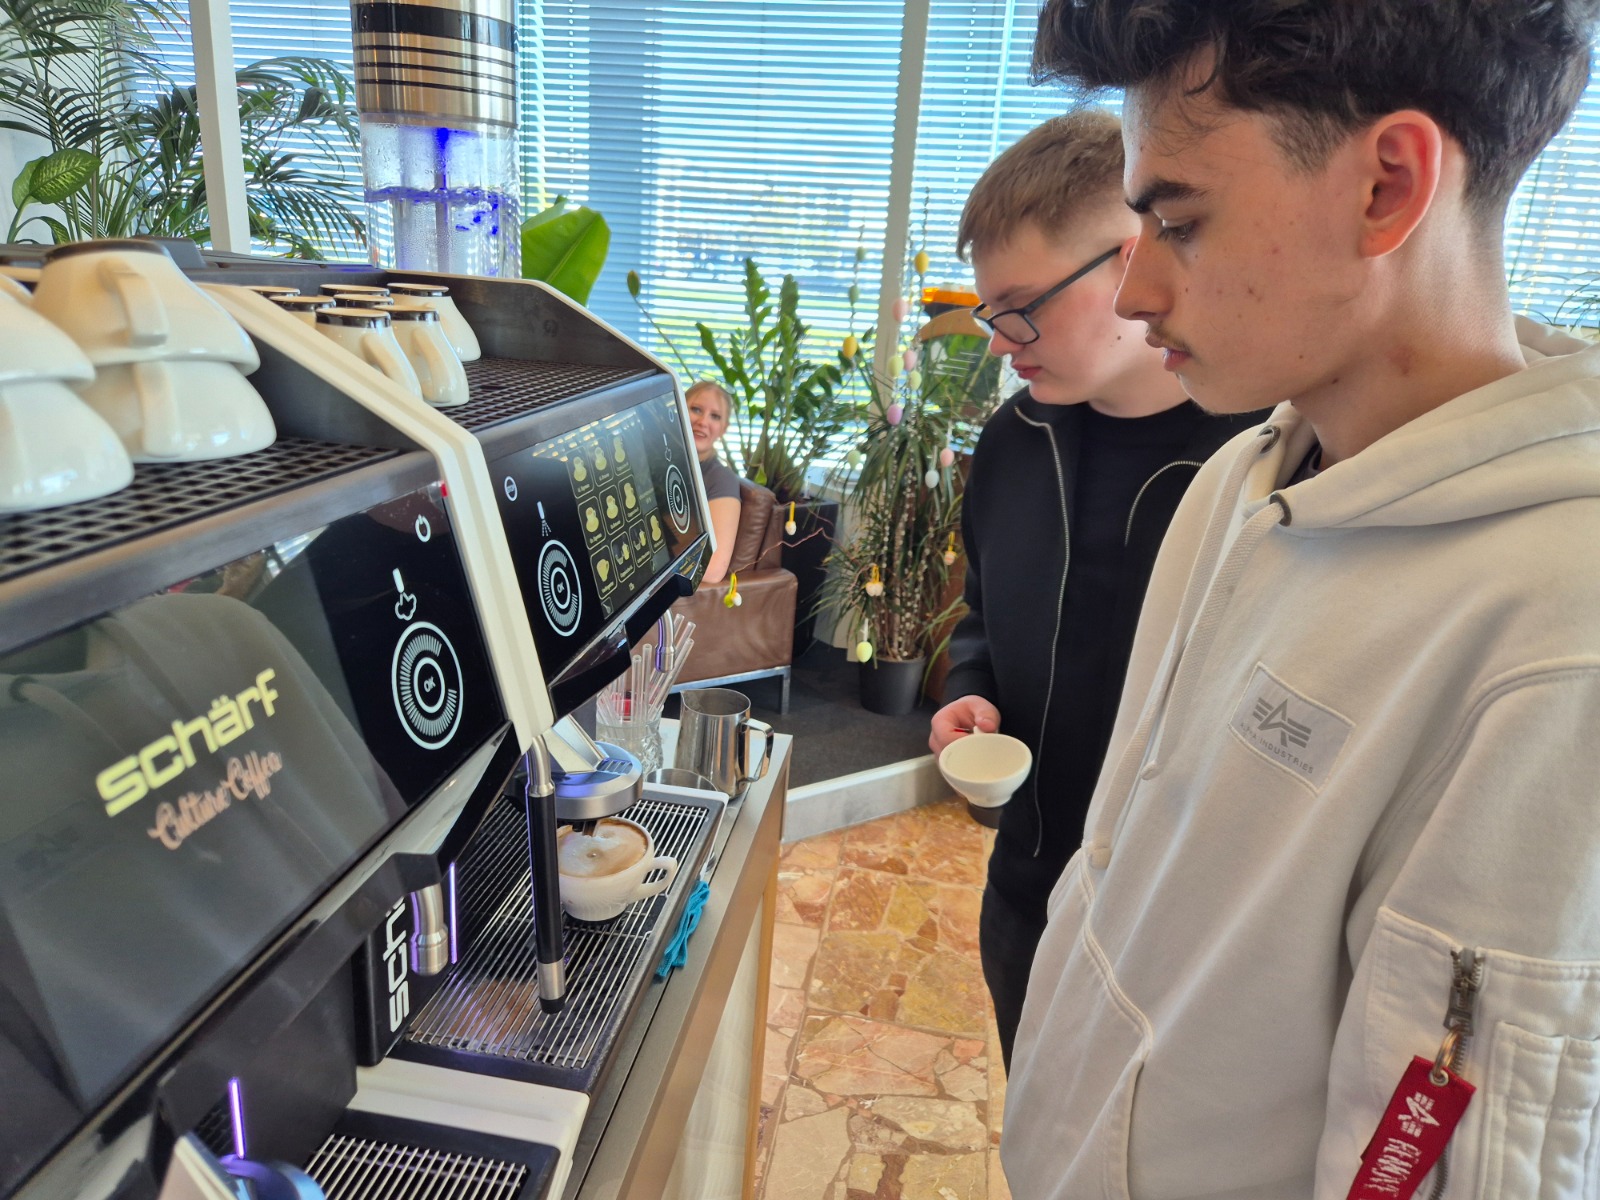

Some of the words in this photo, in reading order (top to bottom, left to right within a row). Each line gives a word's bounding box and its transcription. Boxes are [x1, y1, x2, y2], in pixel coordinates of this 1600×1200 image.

[556, 582, 565, 593] OK
[423, 675, 437, 692] OK
[96, 668, 279, 817] schärf
[1260, 738, 1314, 774] INDUSTRIES
[383, 897, 410, 1033] sch
